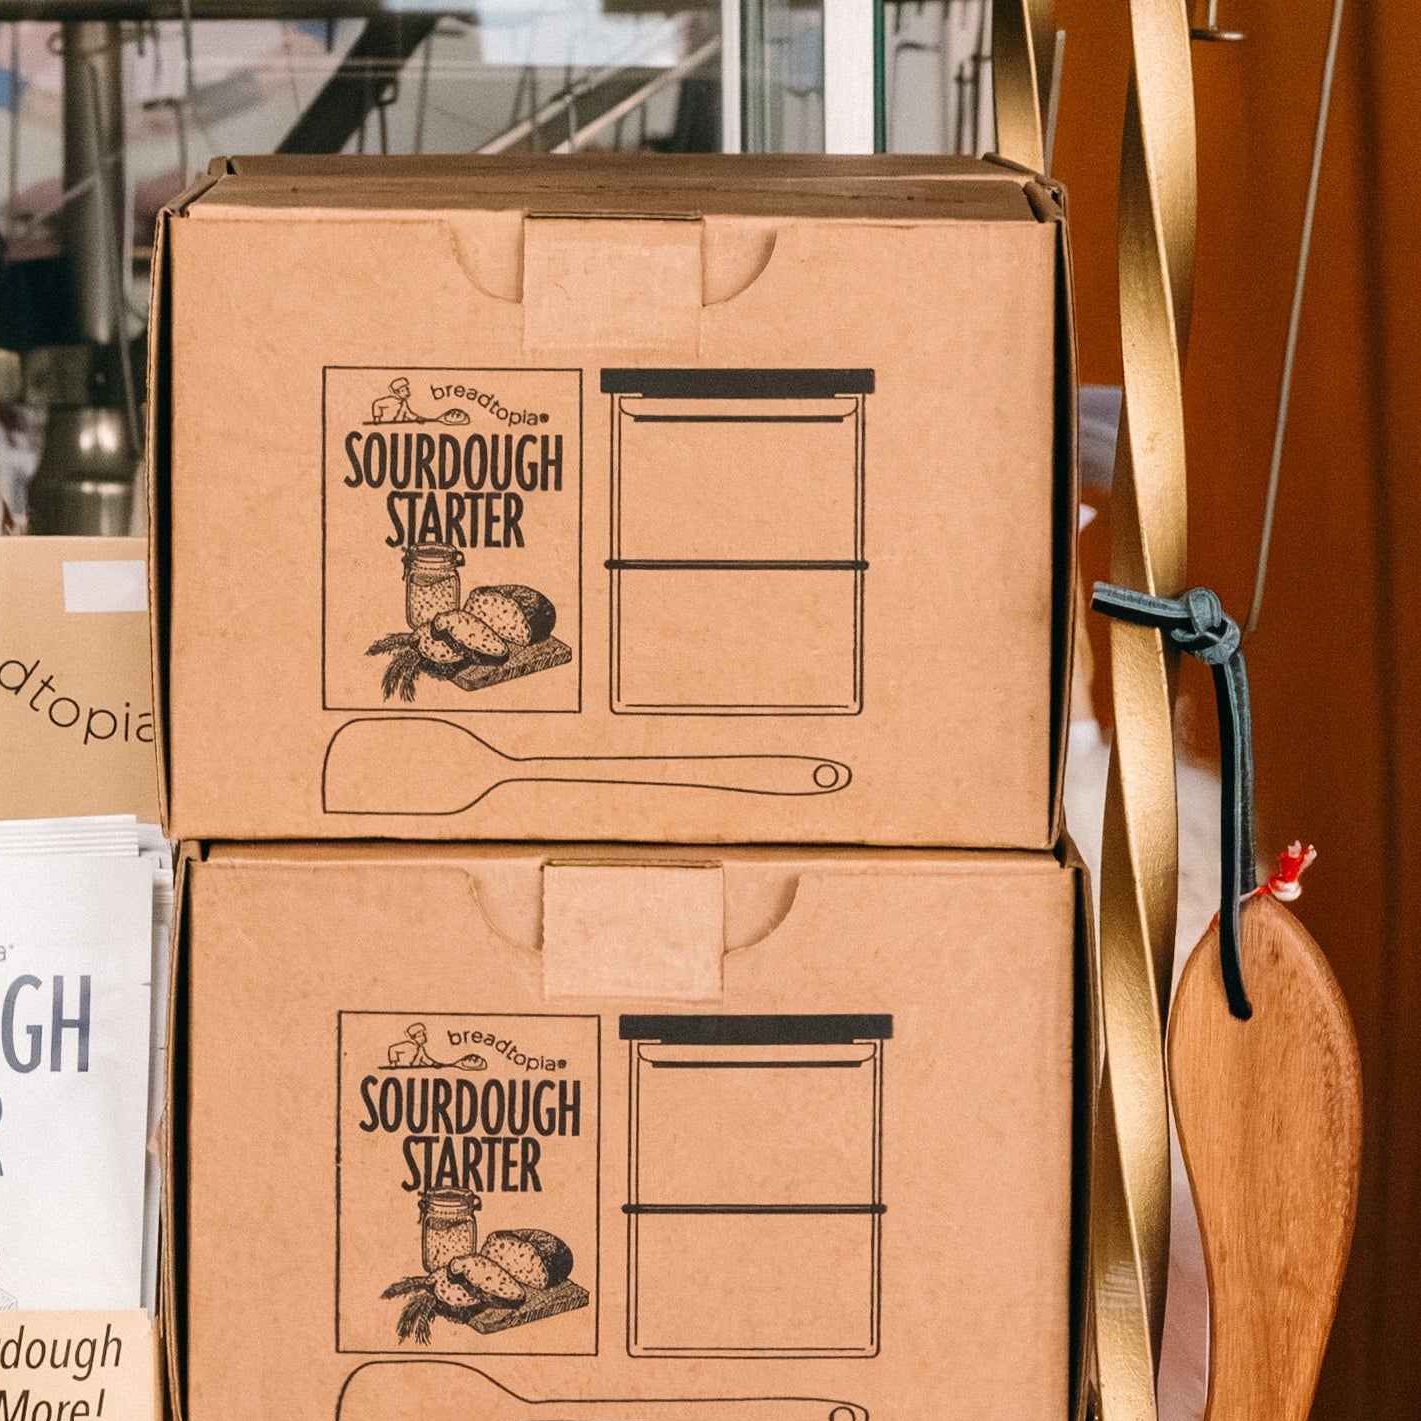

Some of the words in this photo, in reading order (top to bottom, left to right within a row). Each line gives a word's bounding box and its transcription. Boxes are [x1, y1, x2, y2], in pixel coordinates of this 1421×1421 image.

[344, 431, 563, 491] SOURDOUGH
[385, 491, 525, 548] STARTER
[359, 1075, 580, 1136] SOURDOUGH
[401, 1136, 542, 1193] STARTER
